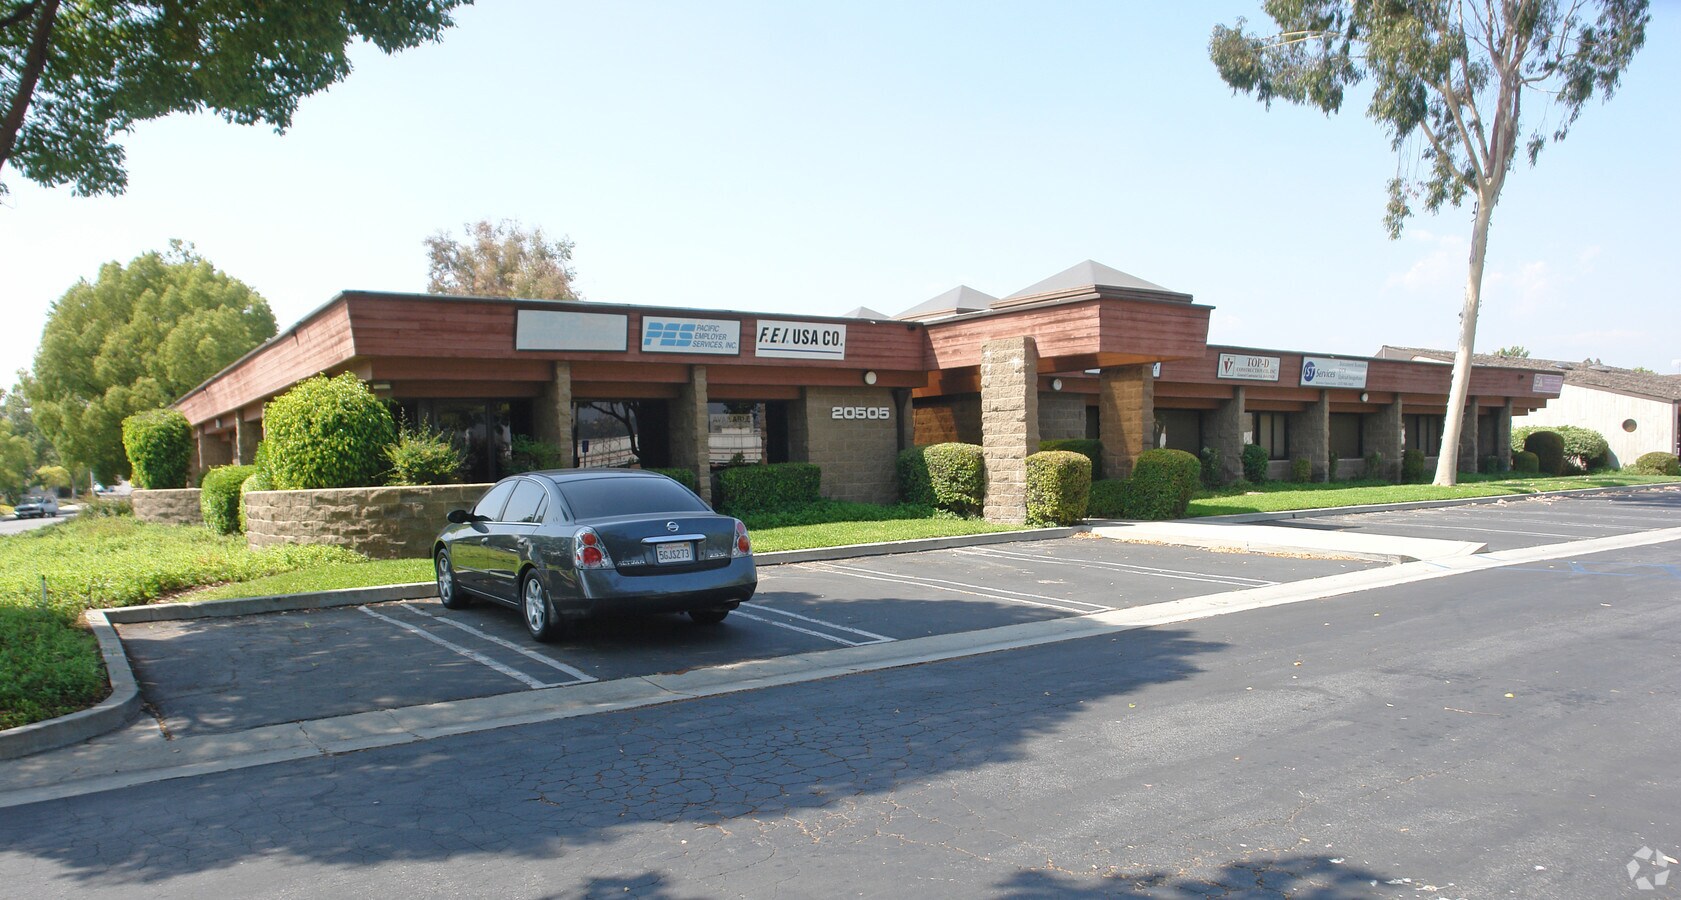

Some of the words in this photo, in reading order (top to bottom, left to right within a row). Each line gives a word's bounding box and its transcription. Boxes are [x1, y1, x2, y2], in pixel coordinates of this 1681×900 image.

[697, 324, 720, 332] PACIFIC
[644, 322, 696, 346] PES
[694, 332, 727, 341] EMPLOYER
[793, 328, 818, 345] USA
[822, 330, 843, 347] CO.
[692, 340, 723, 349] SERVICES,
[1247, 357, 1270, 368] TOP-D
[1316, 368, 1336, 378] Services
[831, 406, 890, 419] 20505
[659, 549, 690, 560] 5GJS273
